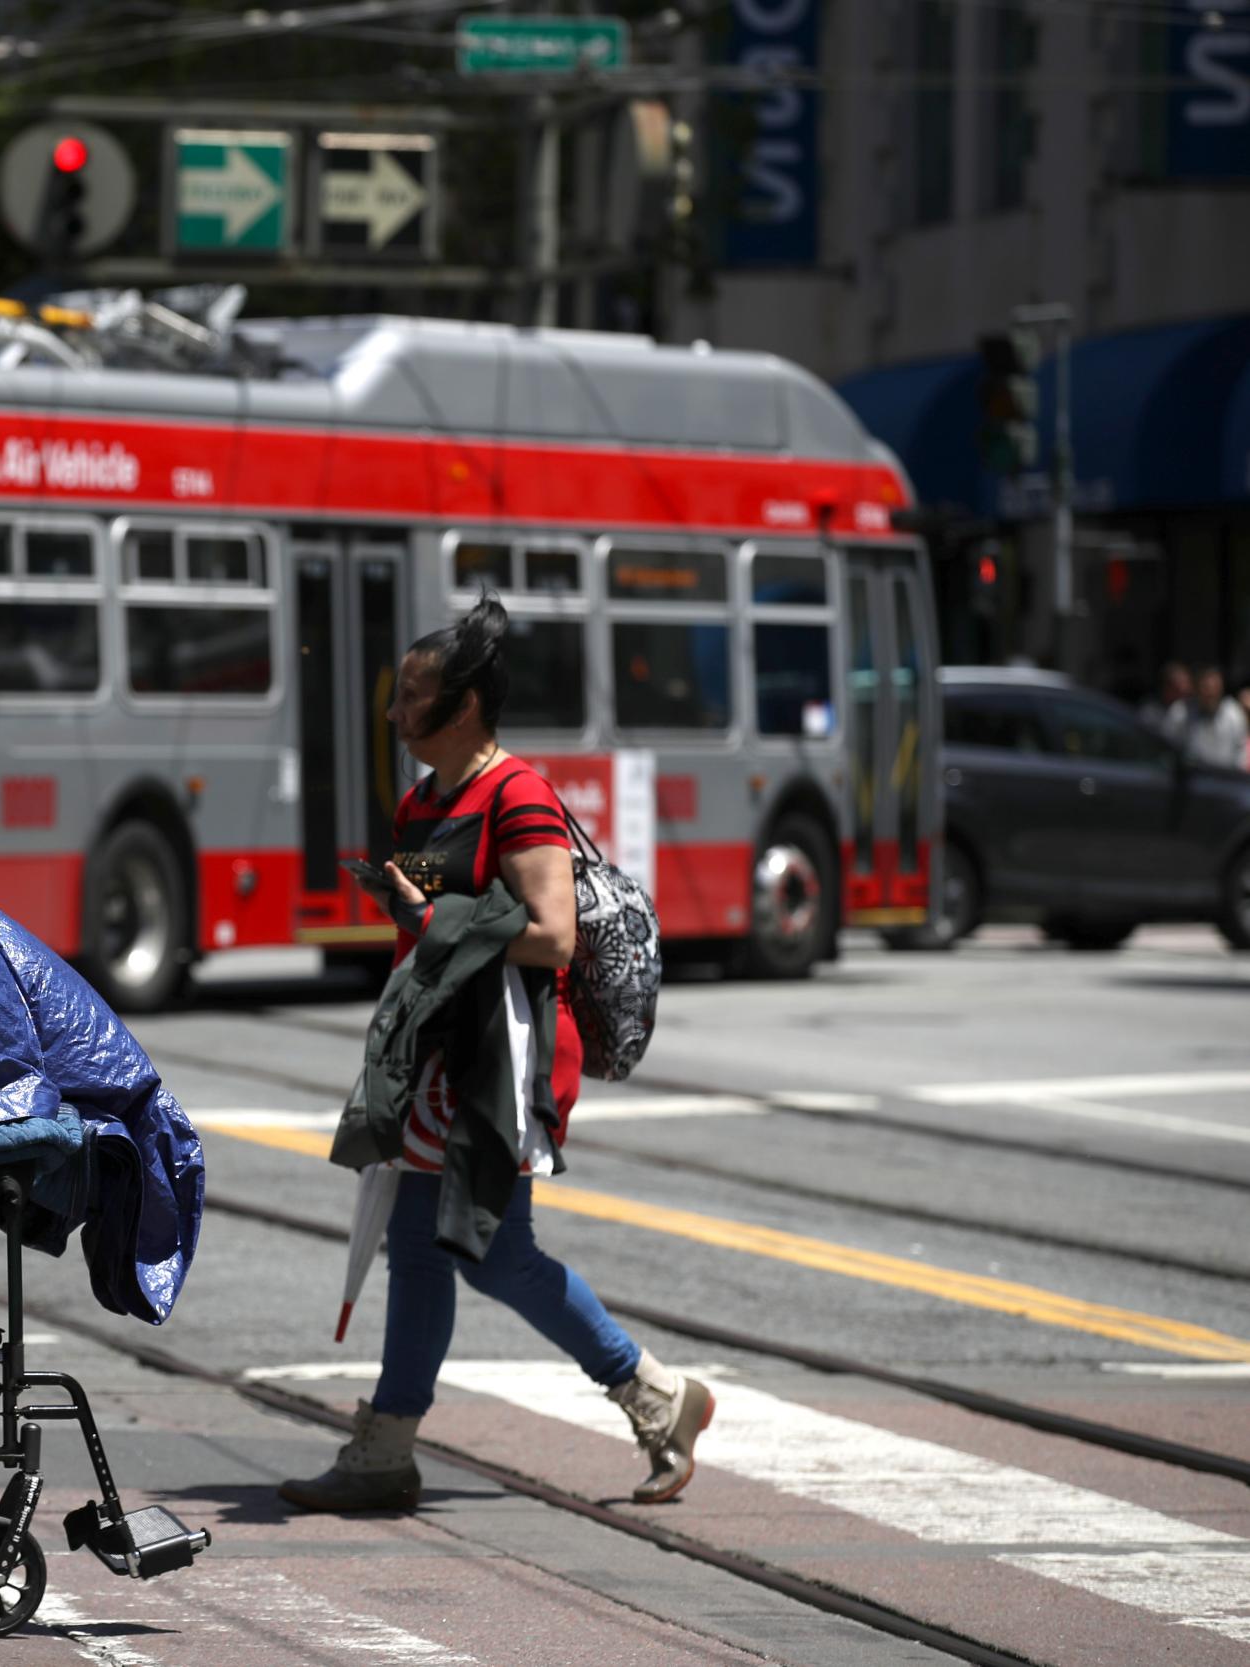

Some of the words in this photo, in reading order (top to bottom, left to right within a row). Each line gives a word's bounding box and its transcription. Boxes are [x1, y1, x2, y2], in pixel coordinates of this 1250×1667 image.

[2, 436, 41, 487] Air
[42, 439, 139, 491] Vehicle
[27, 1476, 39, 1504] Silver
[16, 1505, 31, 1533] Sport
